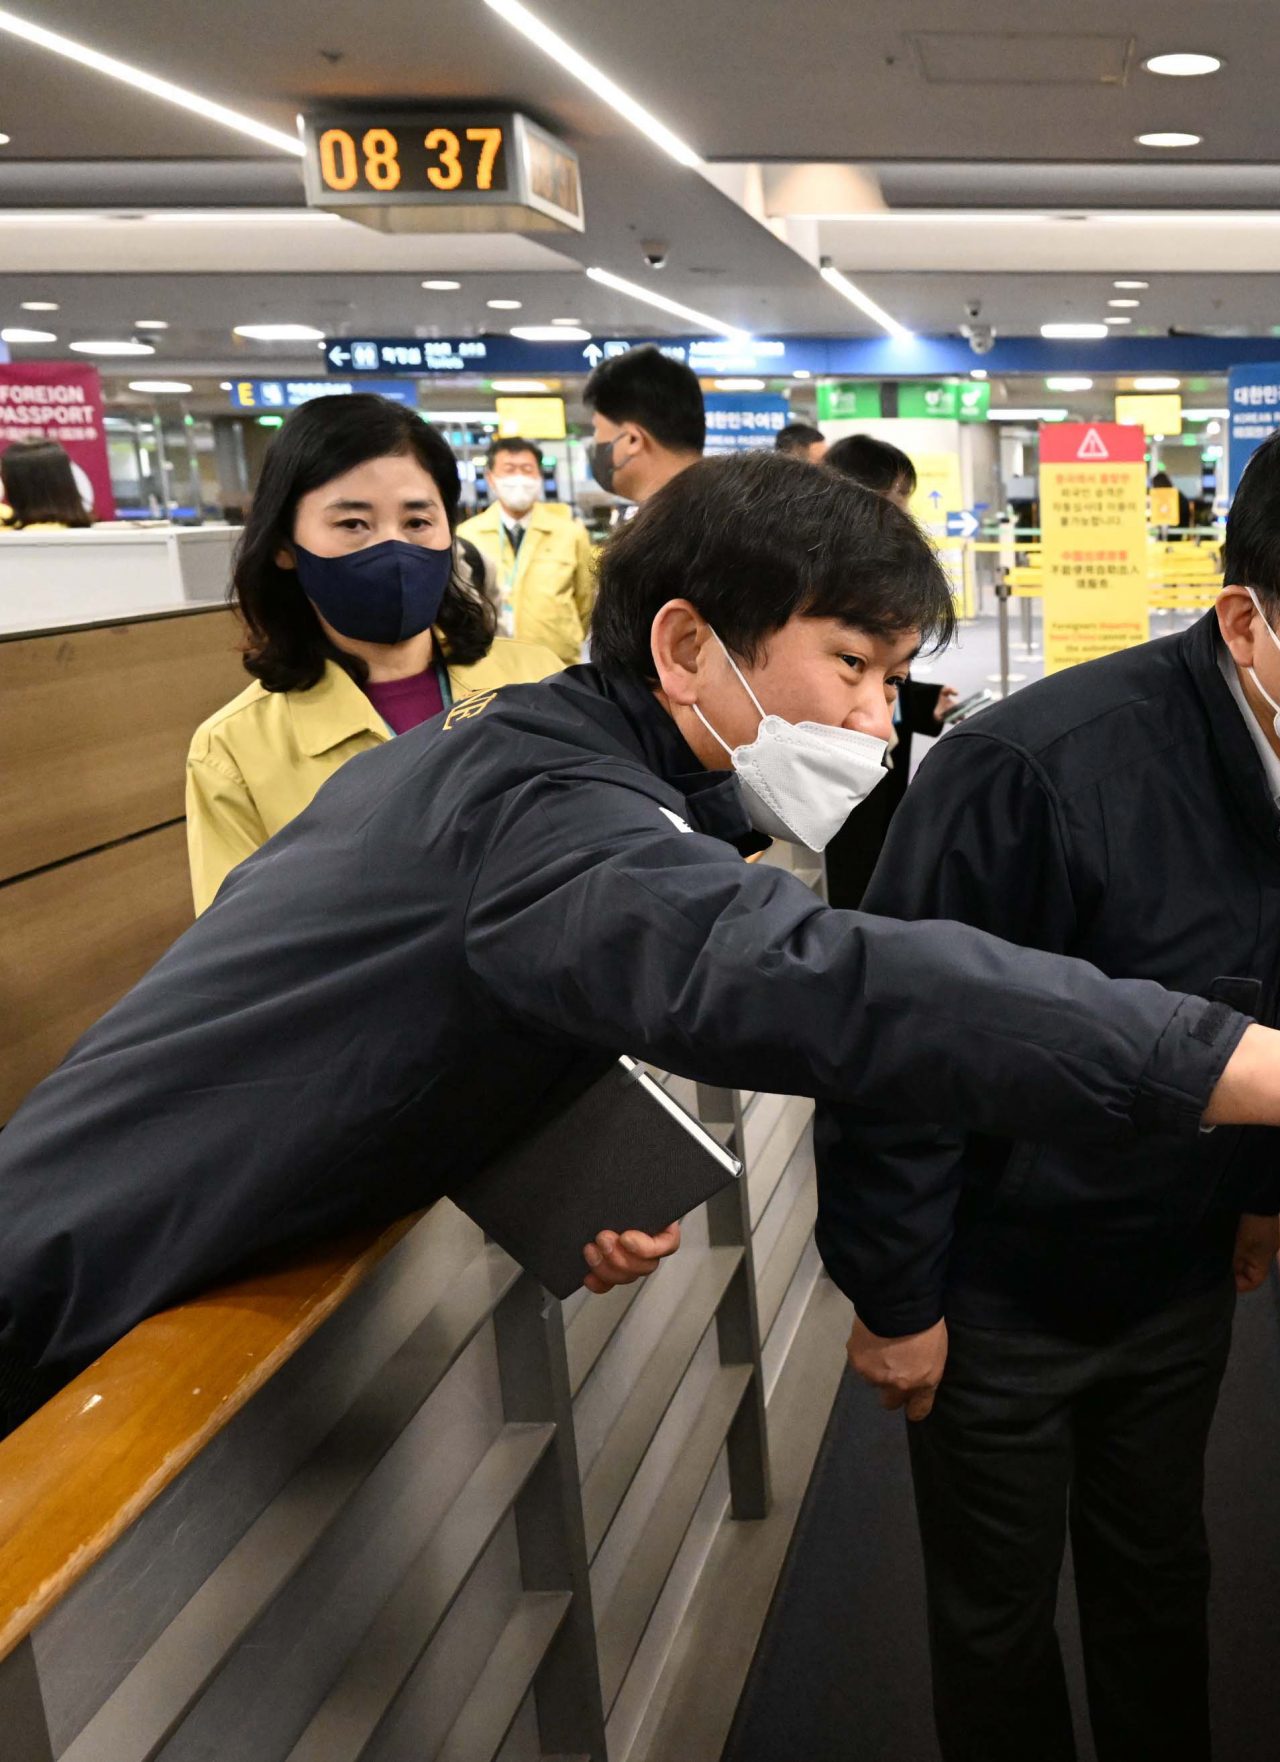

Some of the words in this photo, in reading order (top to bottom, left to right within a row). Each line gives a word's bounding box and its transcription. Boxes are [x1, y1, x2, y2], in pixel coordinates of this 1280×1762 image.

[319, 128, 401, 191] 08
[424, 128, 502, 190] 37
[237, 382, 255, 406] E
